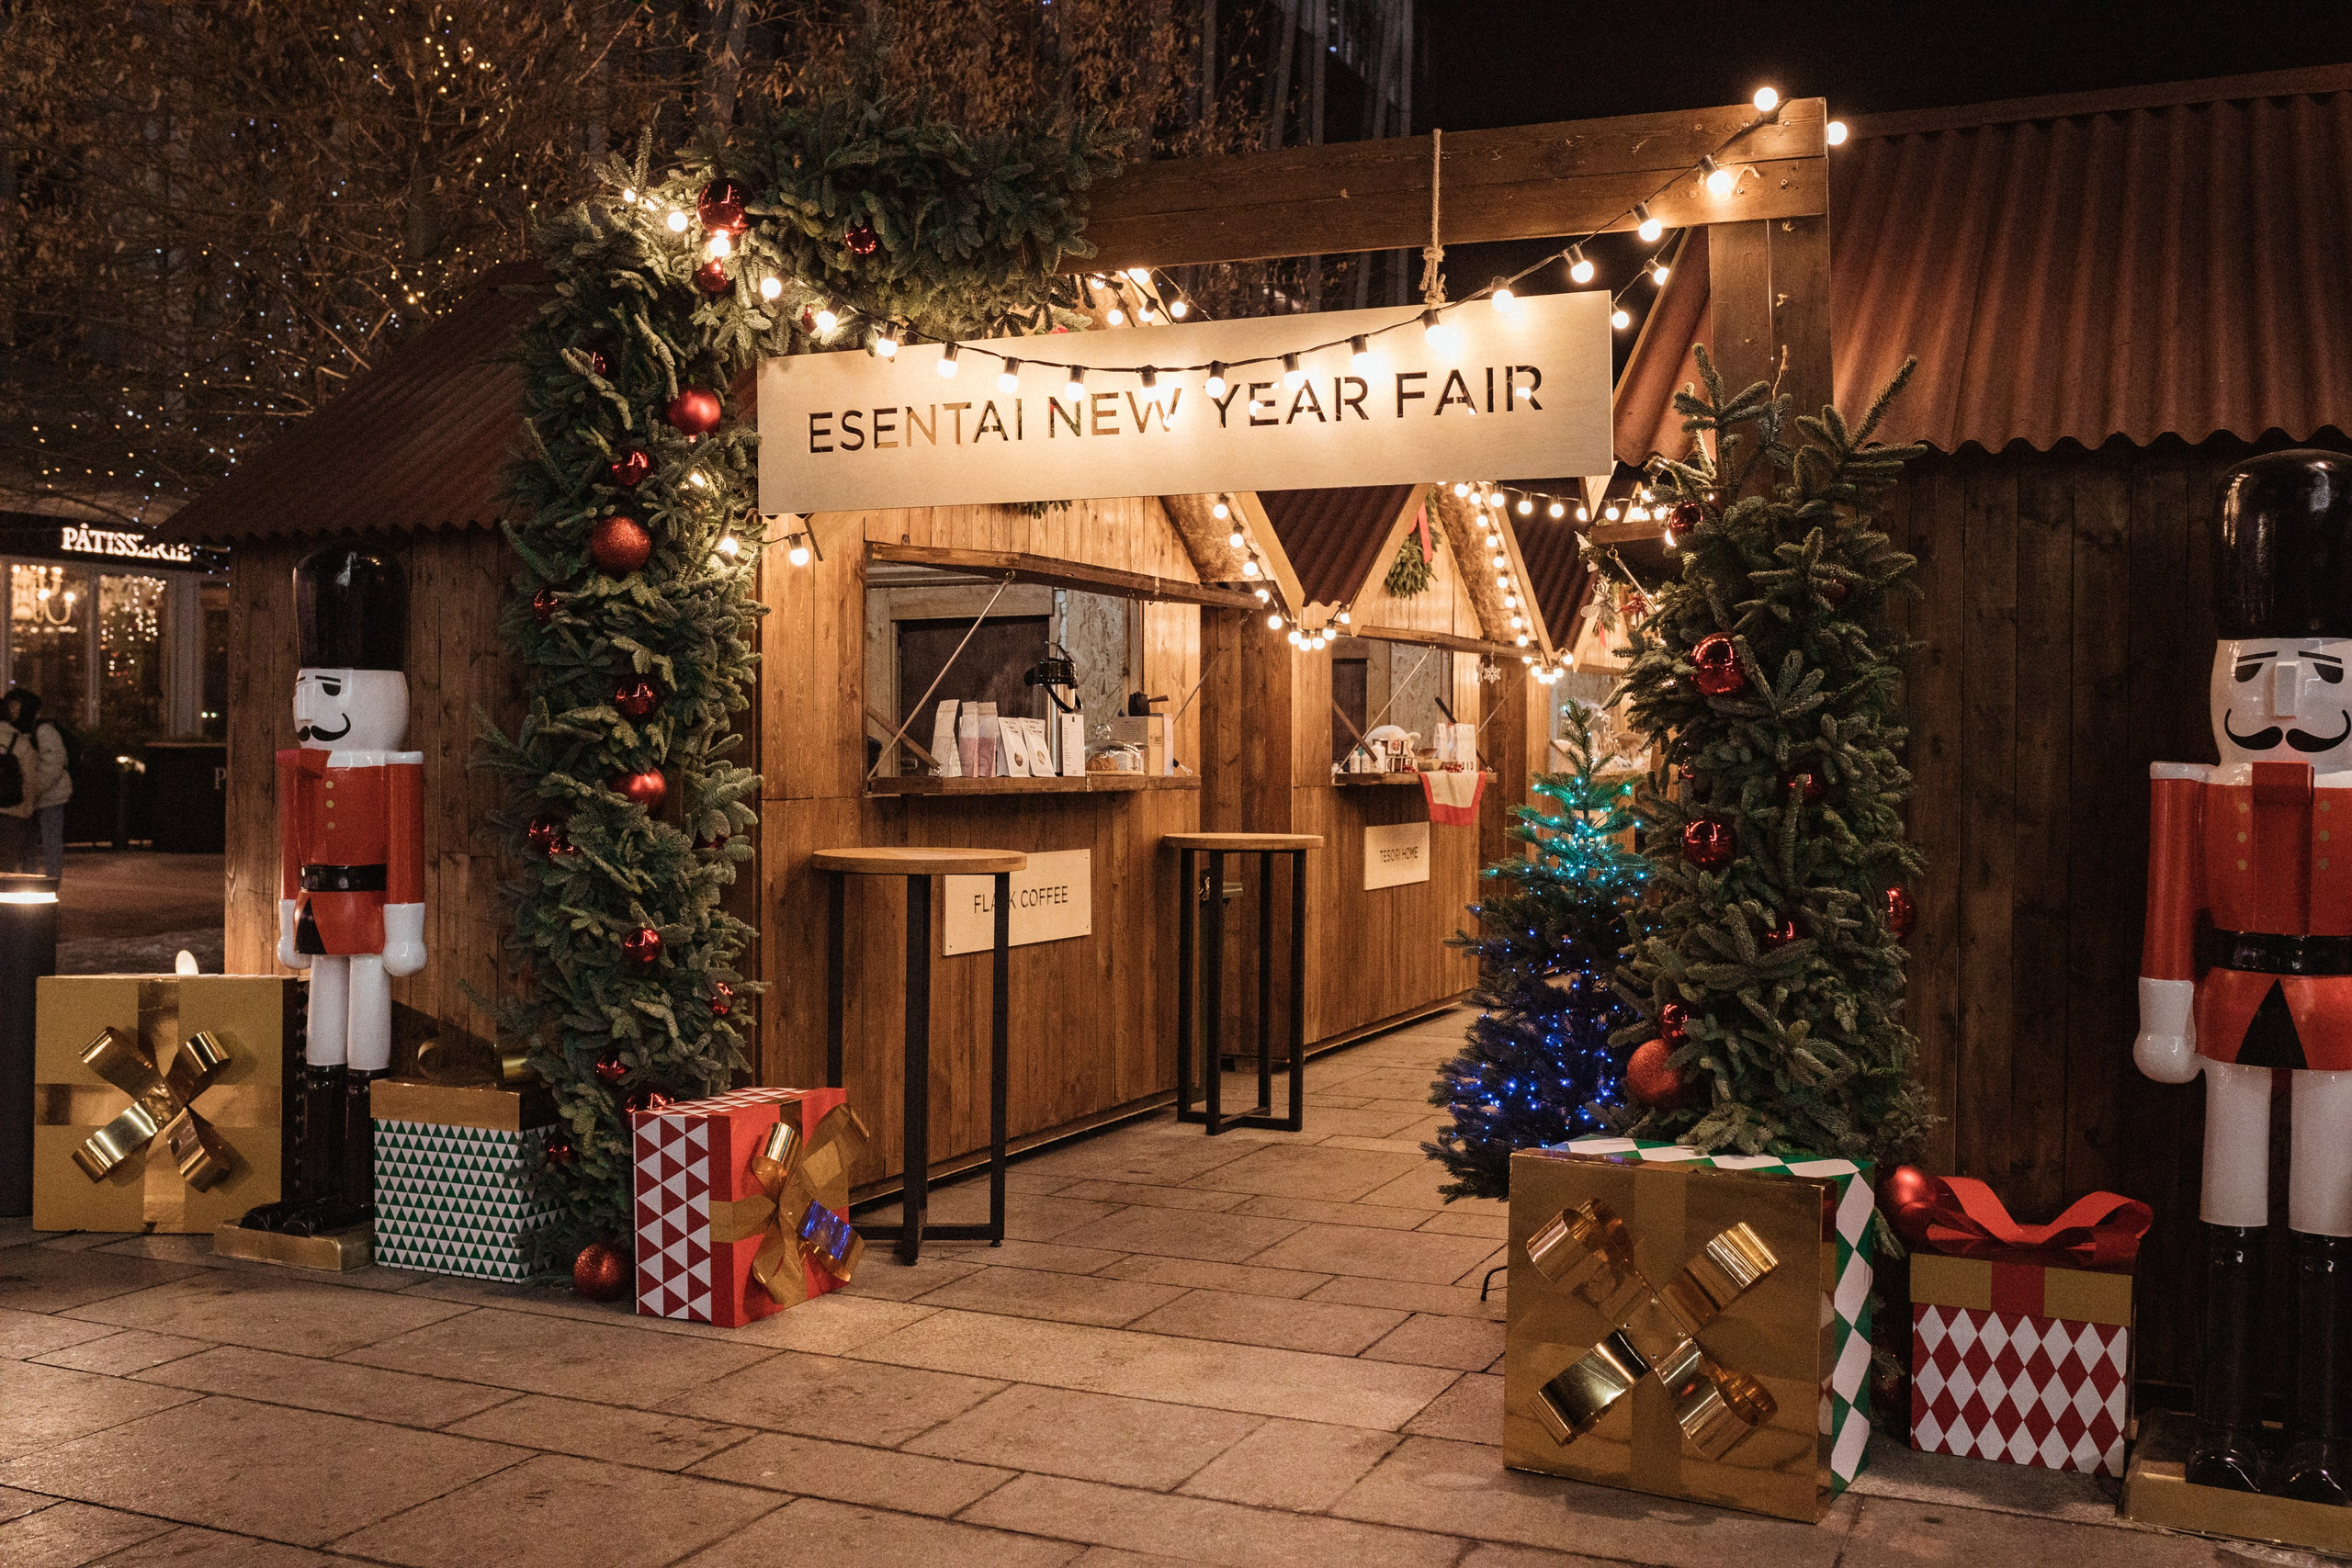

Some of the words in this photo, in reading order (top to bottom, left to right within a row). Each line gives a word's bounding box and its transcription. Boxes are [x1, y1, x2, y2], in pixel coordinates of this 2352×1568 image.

[808, 398, 1023, 454] ESENTAI
[1047, 387, 1182, 439] NEW
[1203, 376, 1370, 429] YEAR
[1395, 365, 1544, 419] FAIR
[1401, 845, 1419, 861] HOME
[974, 890, 1017, 914] FLK
[1020, 885, 1069, 908] COFFEE
